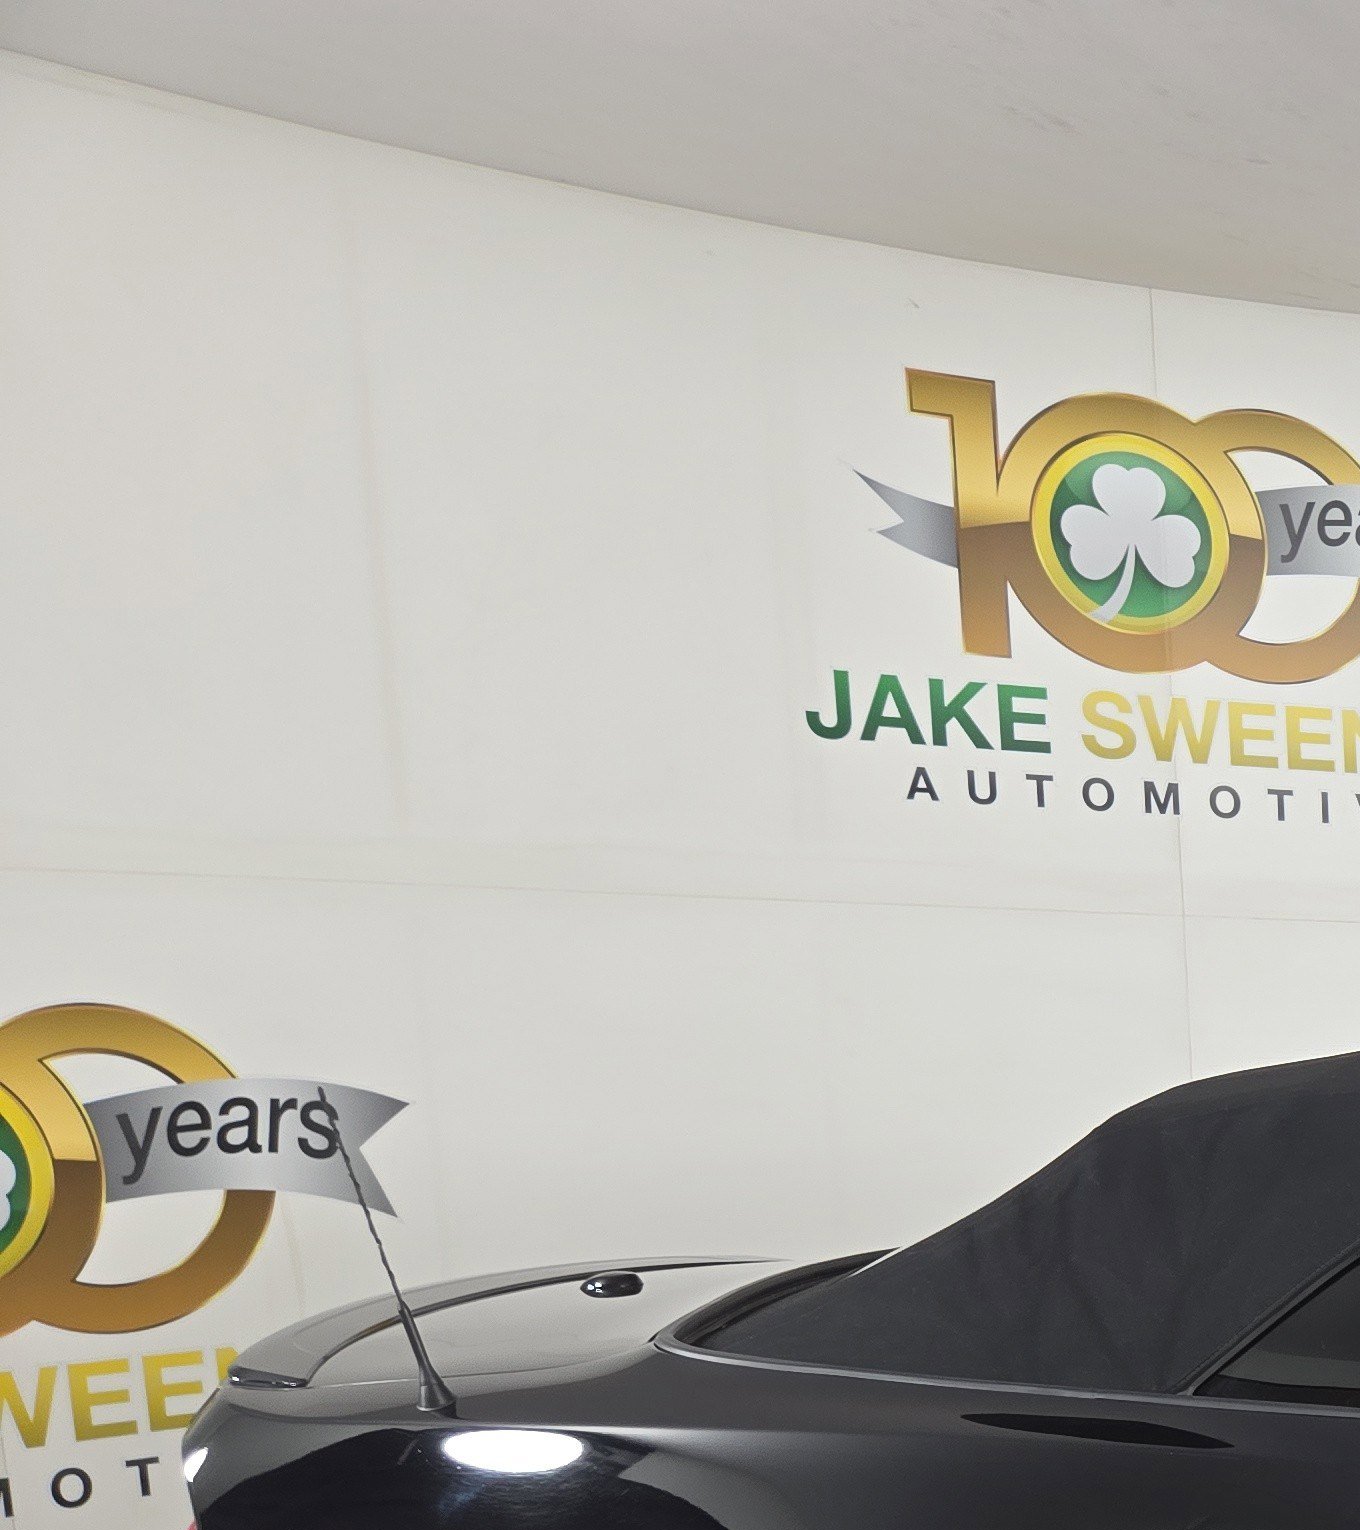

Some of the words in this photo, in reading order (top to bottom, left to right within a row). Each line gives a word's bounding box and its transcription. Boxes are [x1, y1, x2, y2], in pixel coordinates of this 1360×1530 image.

[806, 670, 1052, 754] JAKE
[116, 1096, 340, 1184] years
[0, 1456, 160, 1518] OT
